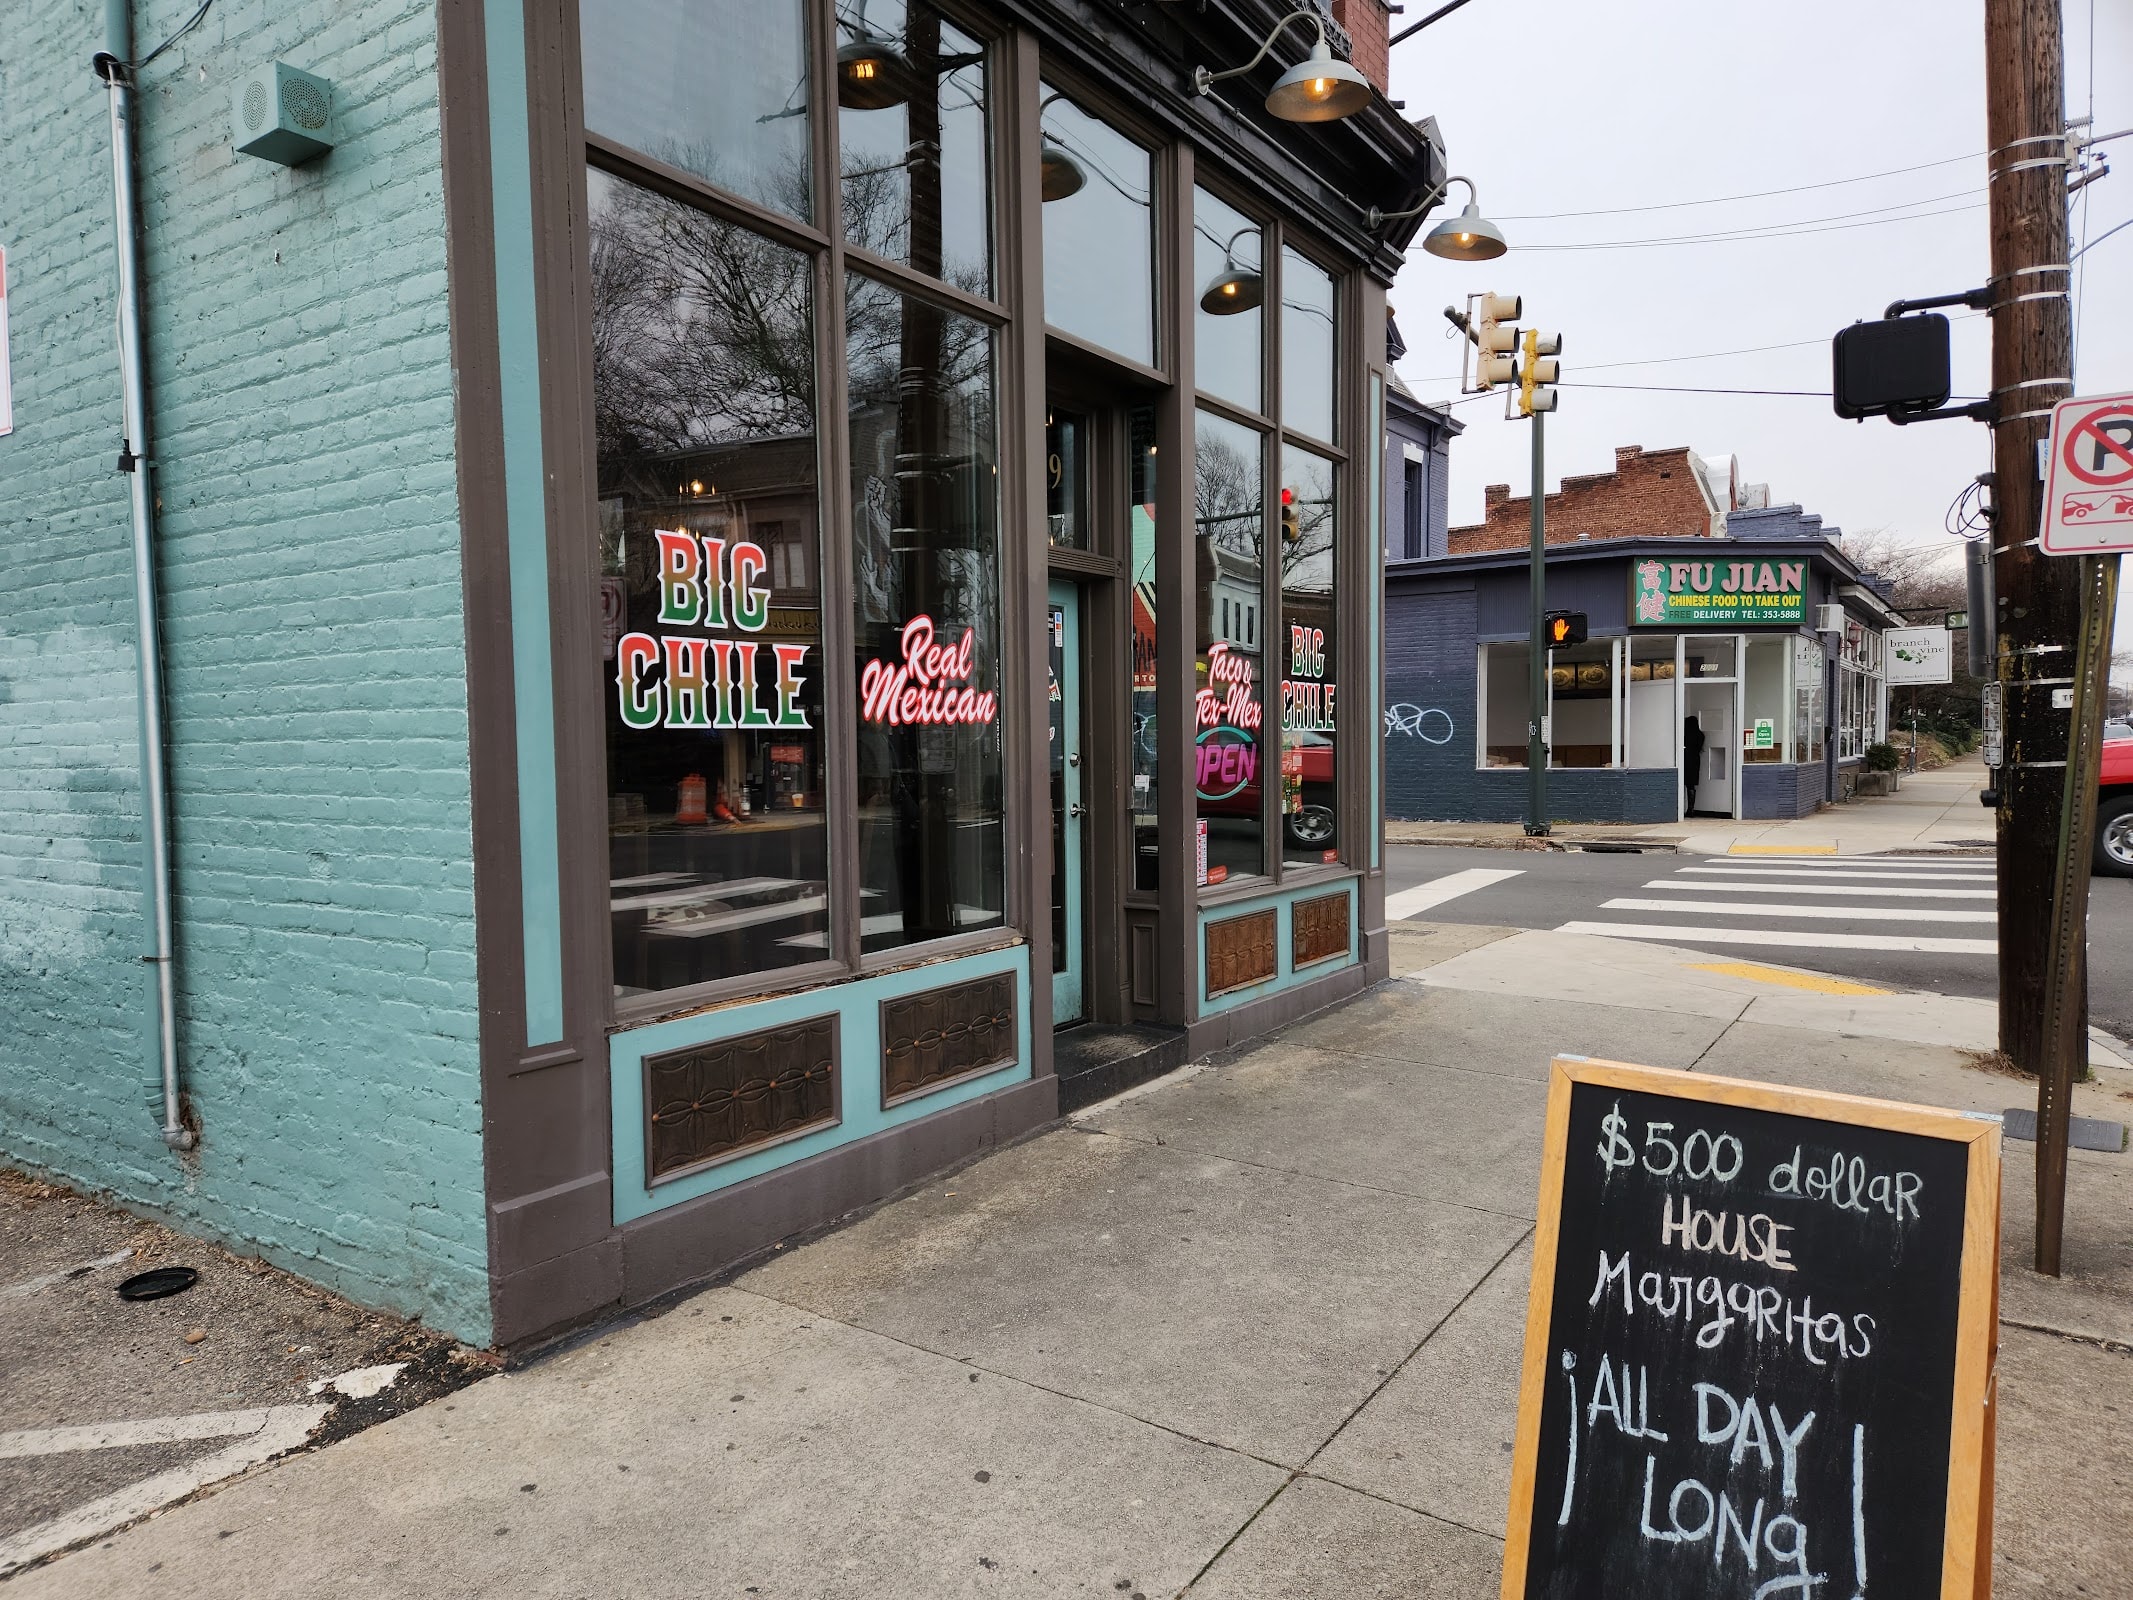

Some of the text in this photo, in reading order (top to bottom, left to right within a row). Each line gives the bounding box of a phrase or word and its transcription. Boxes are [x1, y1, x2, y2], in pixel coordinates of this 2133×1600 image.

[1049, 453, 1062, 489] 9
[655, 529, 771, 632] BIG
[1668, 562, 1805, 593] FU JIAN
[1669, 595, 1801, 607] CHINESE FOOD TO TAKE OUT
[1669, 610, 1801, 619] FREE DELIVERY TEL: 353-5888
[1949, 615, 1956, 627] S
[902, 614, 974, 687] Real
[1208, 641, 1244, 686] Taco
[1291, 624, 1325, 679] BIG
[1890, 637, 1930, 648] branch
[1920, 646, 1945, 654] vine
[616, 632, 813, 730] CHILE
[861, 658, 997, 727] Mexican
[1196, 682, 1262, 731] Tex-Mex
[1282, 680, 1337, 732] CHILE
[1662, 1193, 1798, 1271] HOUSE
[1692, 1382, 1816, 1500] DAY
